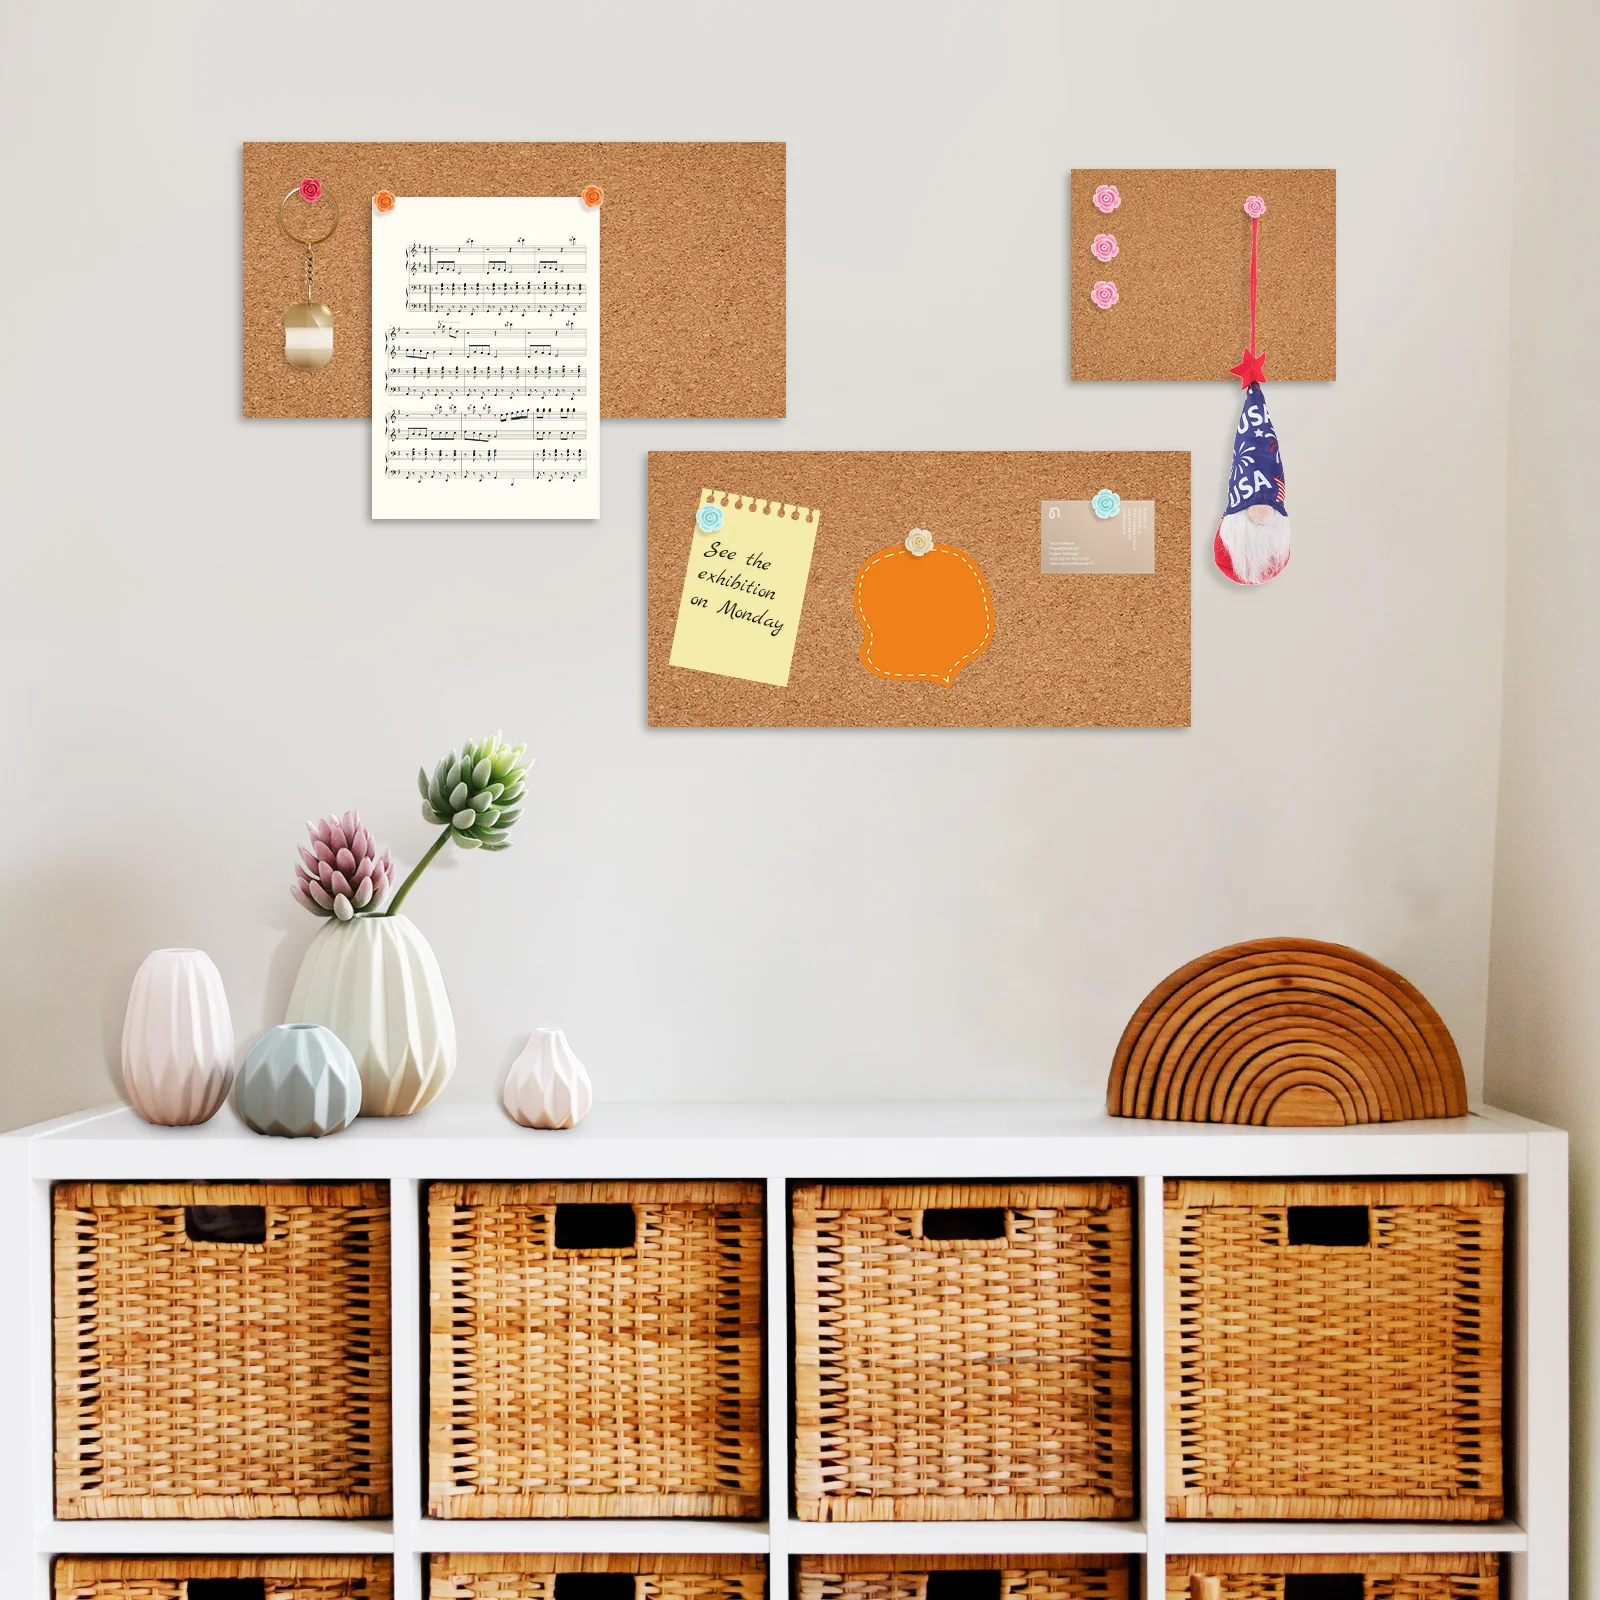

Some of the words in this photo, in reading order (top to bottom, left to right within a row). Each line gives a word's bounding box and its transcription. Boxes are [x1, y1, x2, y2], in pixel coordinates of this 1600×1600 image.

[1229, 470, 1272, 508] USA
[703, 541, 737, 560] See
[746, 552, 772, 570] the
[698, 569, 776, 600] exhibition
[690, 596, 708, 608] on
[716, 599, 784, 637] Monday
